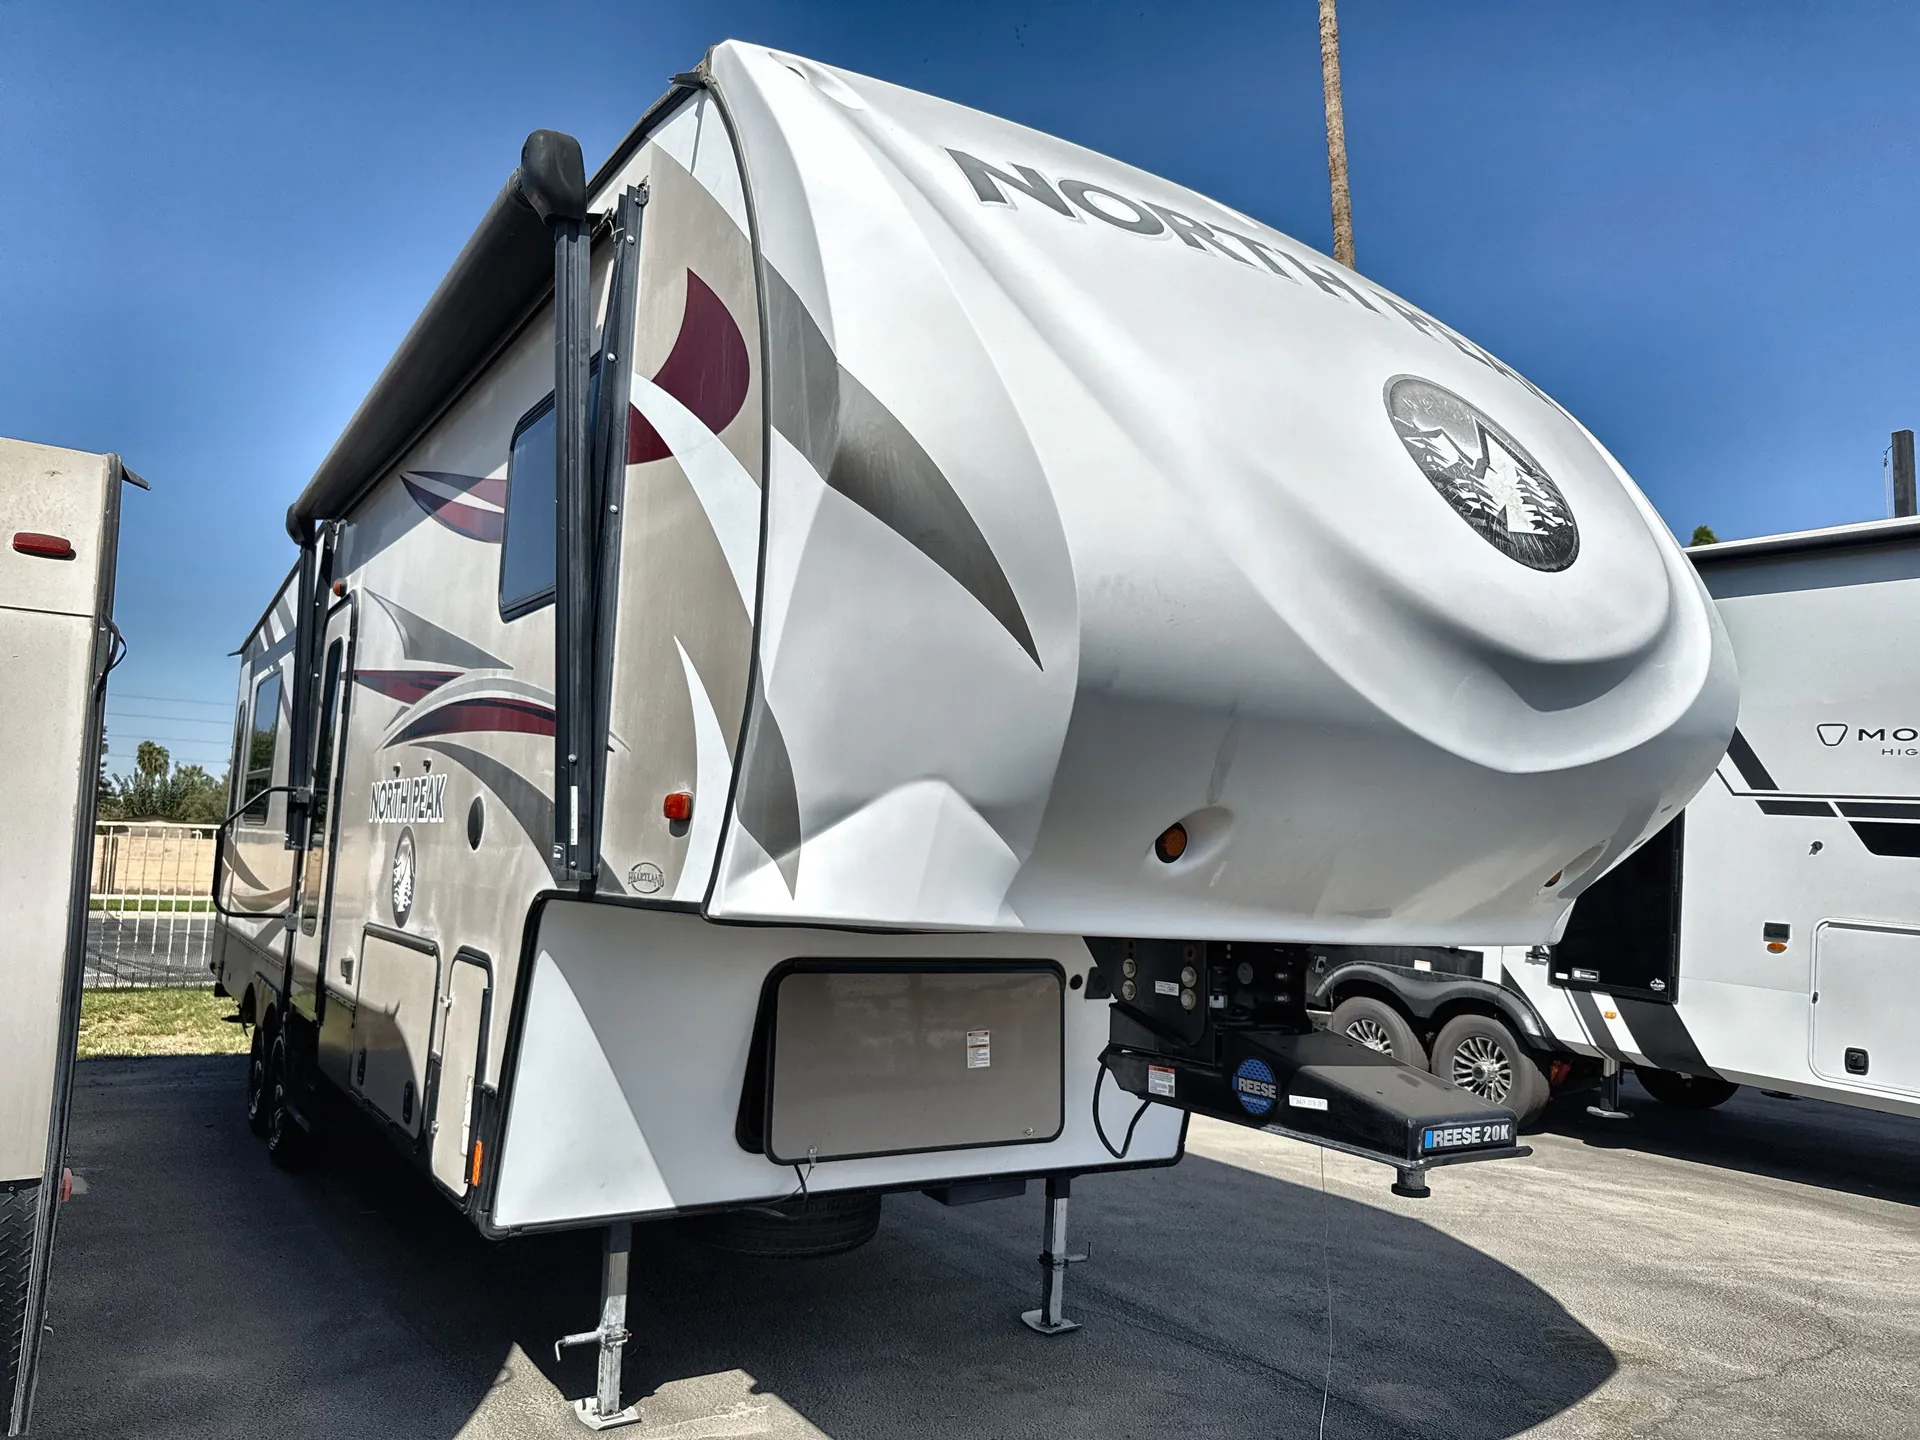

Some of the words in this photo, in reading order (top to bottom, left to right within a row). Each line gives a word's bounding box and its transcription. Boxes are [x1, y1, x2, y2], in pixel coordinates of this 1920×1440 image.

[944, 147, 1383, 317] NORTH
[1858, 728, 1919, 741] MO
[370, 778, 411, 823] NORTH
[409, 774, 448, 823] PEAK
[1238, 1077, 1277, 1099] REESE
[1433, 1126, 1481, 1147] REESE
[1483, 1124, 1510, 1142] 20K
